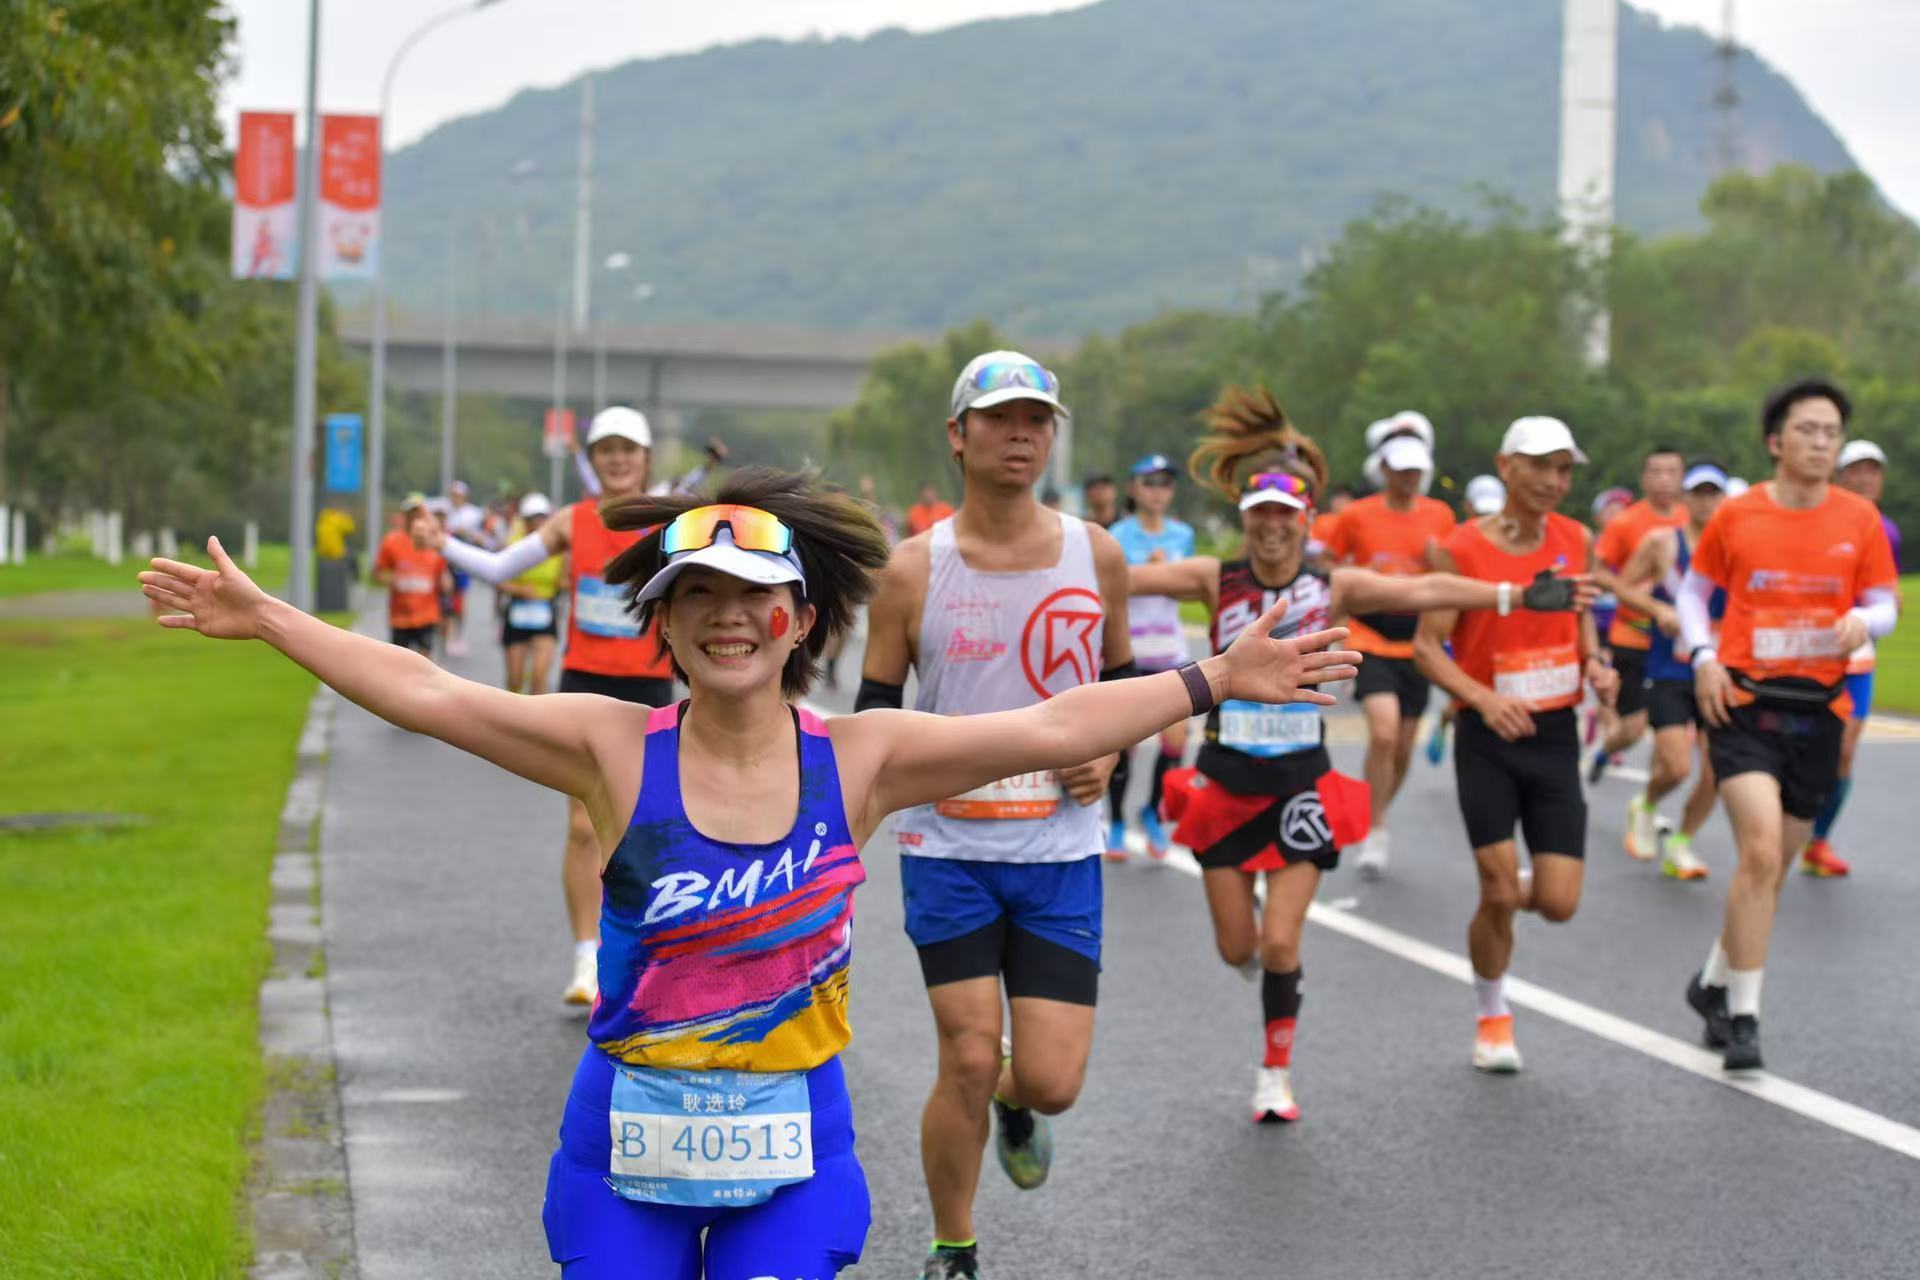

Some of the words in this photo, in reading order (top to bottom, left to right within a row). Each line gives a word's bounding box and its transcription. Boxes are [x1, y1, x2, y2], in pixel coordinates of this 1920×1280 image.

[683, 1093, 747, 1112] 耿选玲
[621, 1121, 647, 1159] B
[672, 1121, 803, 1162] 40513
